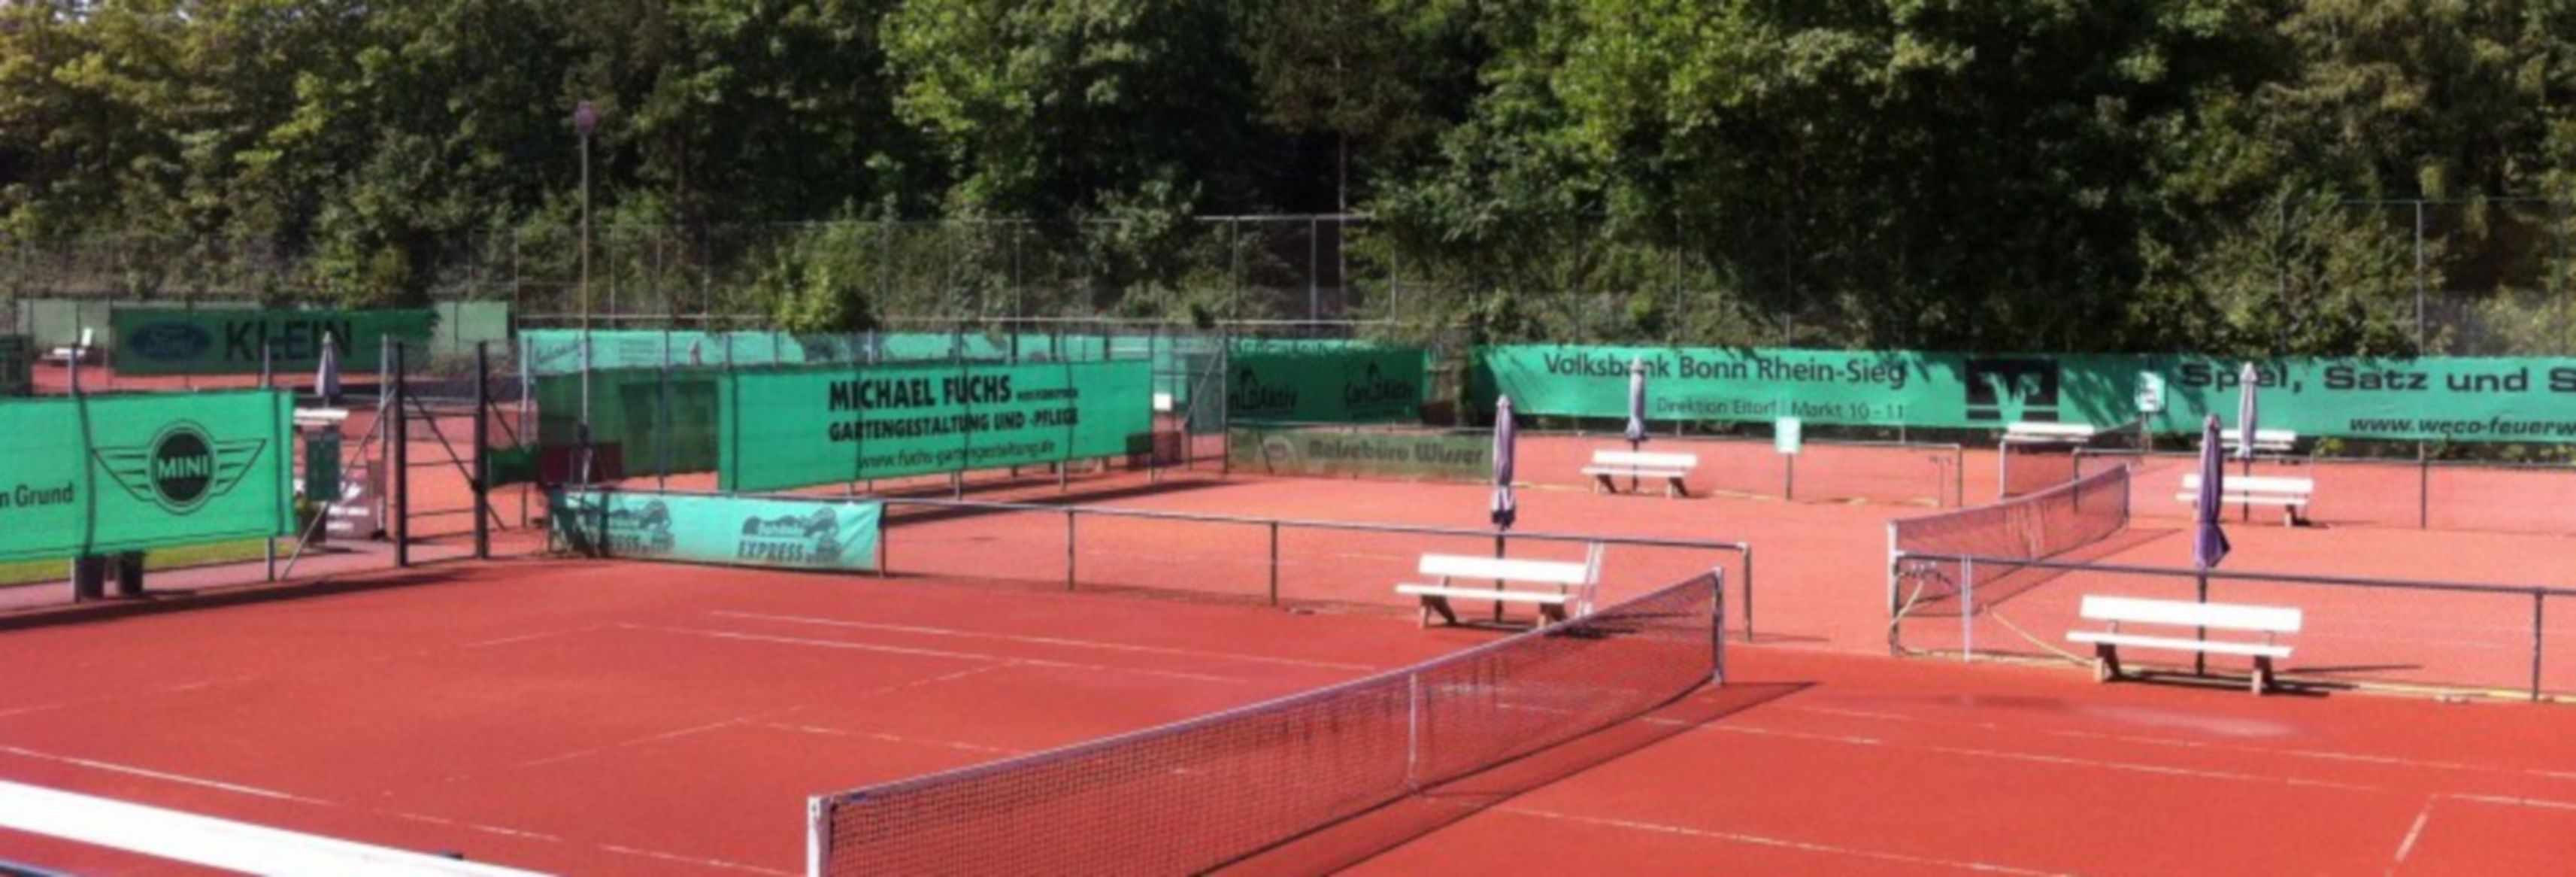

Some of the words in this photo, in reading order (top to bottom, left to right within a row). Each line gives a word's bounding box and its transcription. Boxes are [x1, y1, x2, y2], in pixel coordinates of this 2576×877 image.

[226, 320, 352, 362] KLEIN
[1679, 356, 1747, 378] Bonn
[1757, 357, 1907, 390] Rhein-Sieg
[2182, 363, 2302, 393] Spel,
[2323, 366, 2429, 391] Satz
[2447, 367, 2529, 392] und
[829, 378, 935, 411] MICHAEL
[943, 375, 1011, 405] FUCHS
[1657, 396, 1727, 414] Direktion
[1792, 401, 1842, 417] Markt
[1850, 402, 1870, 419] 10
[1887, 404, 1905, 419] 11
[829, 414, 989, 442] GARTENGESTALTUNG
[994, 411, 1026, 431] UND
[158, 454, 209, 479] MINI
[15, 481, 74, 508] Grund
[737, 539, 805, 561] EXPRESS
